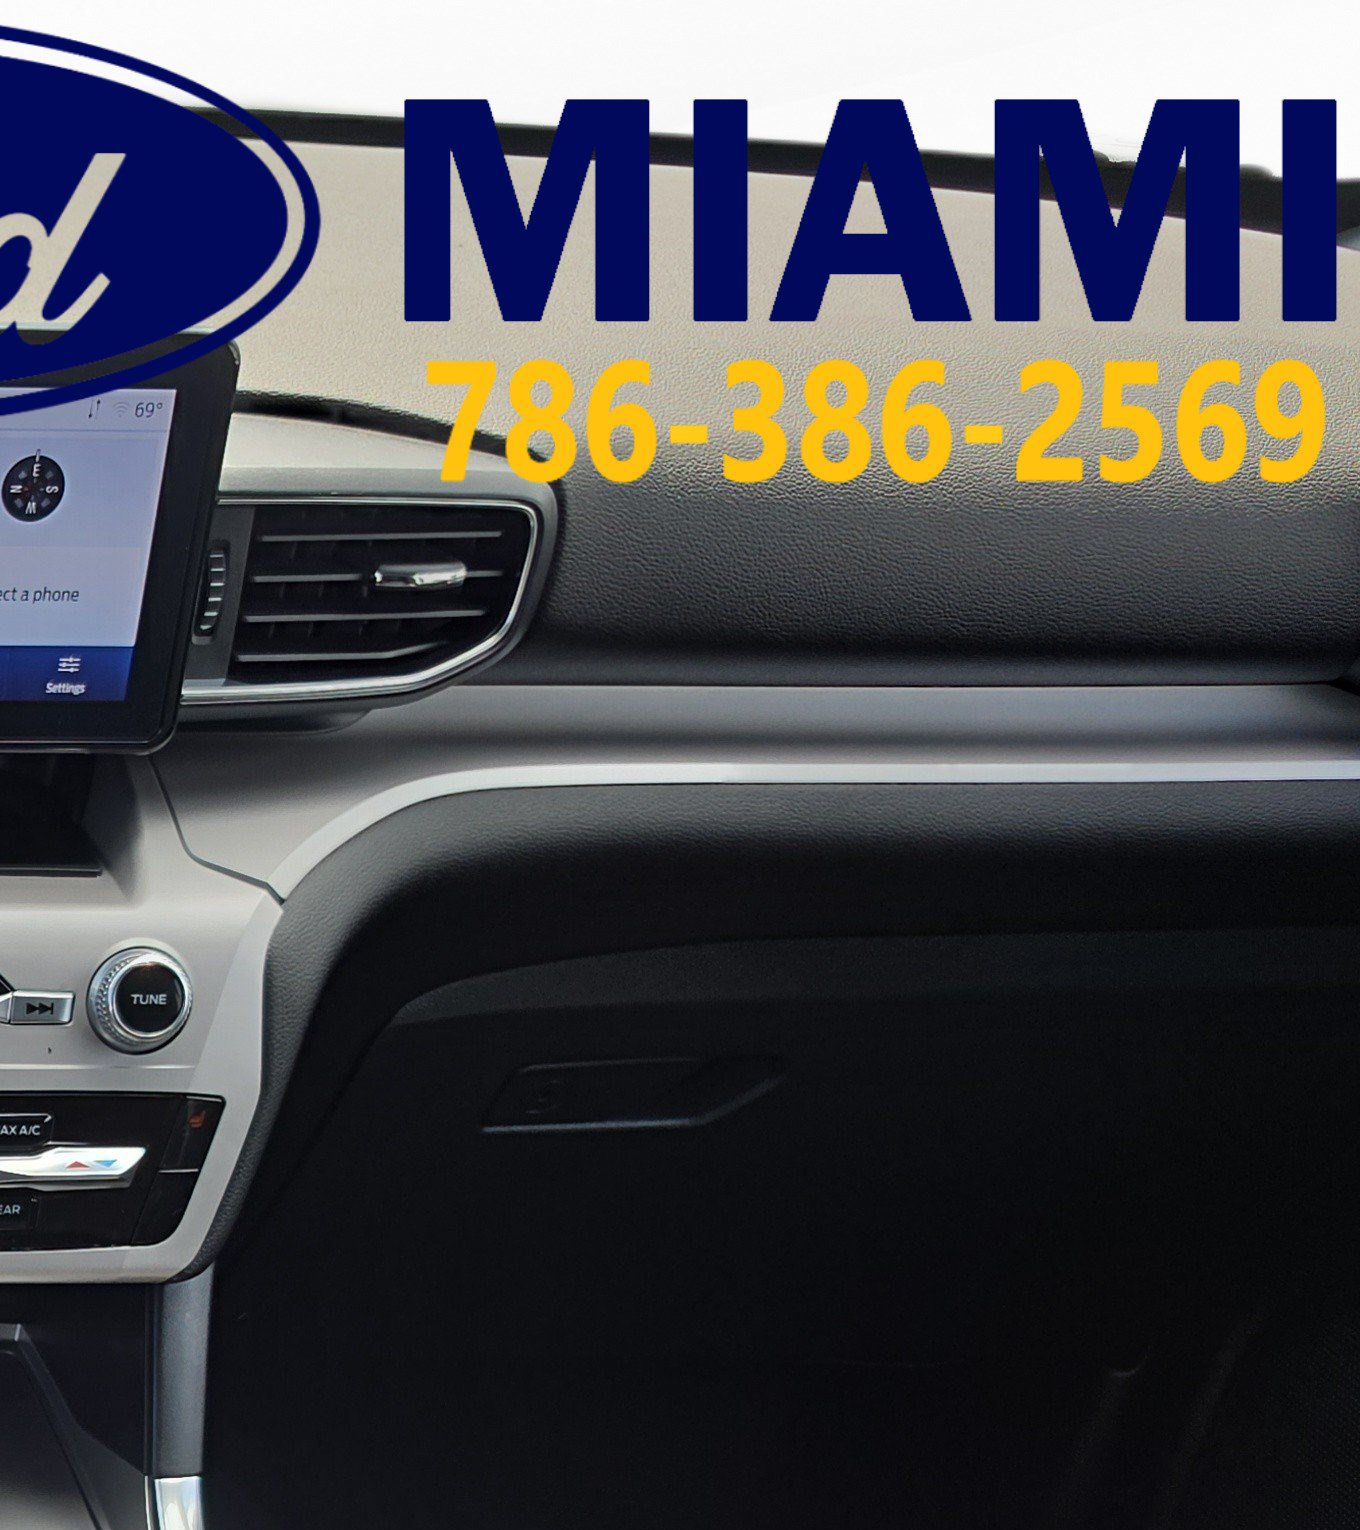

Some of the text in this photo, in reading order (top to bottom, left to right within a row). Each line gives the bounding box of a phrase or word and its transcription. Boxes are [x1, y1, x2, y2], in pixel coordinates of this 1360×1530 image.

[134, 401, 164, 419] 69°
[32, 463, 41, 477] E
[20, 590, 29, 603] a
[32, 586, 80, 608] phone
[45, 681, 85, 695] Settings
[130, 993, 168, 1005] TUNE
[19, 1124, 41, 1137] A/C
